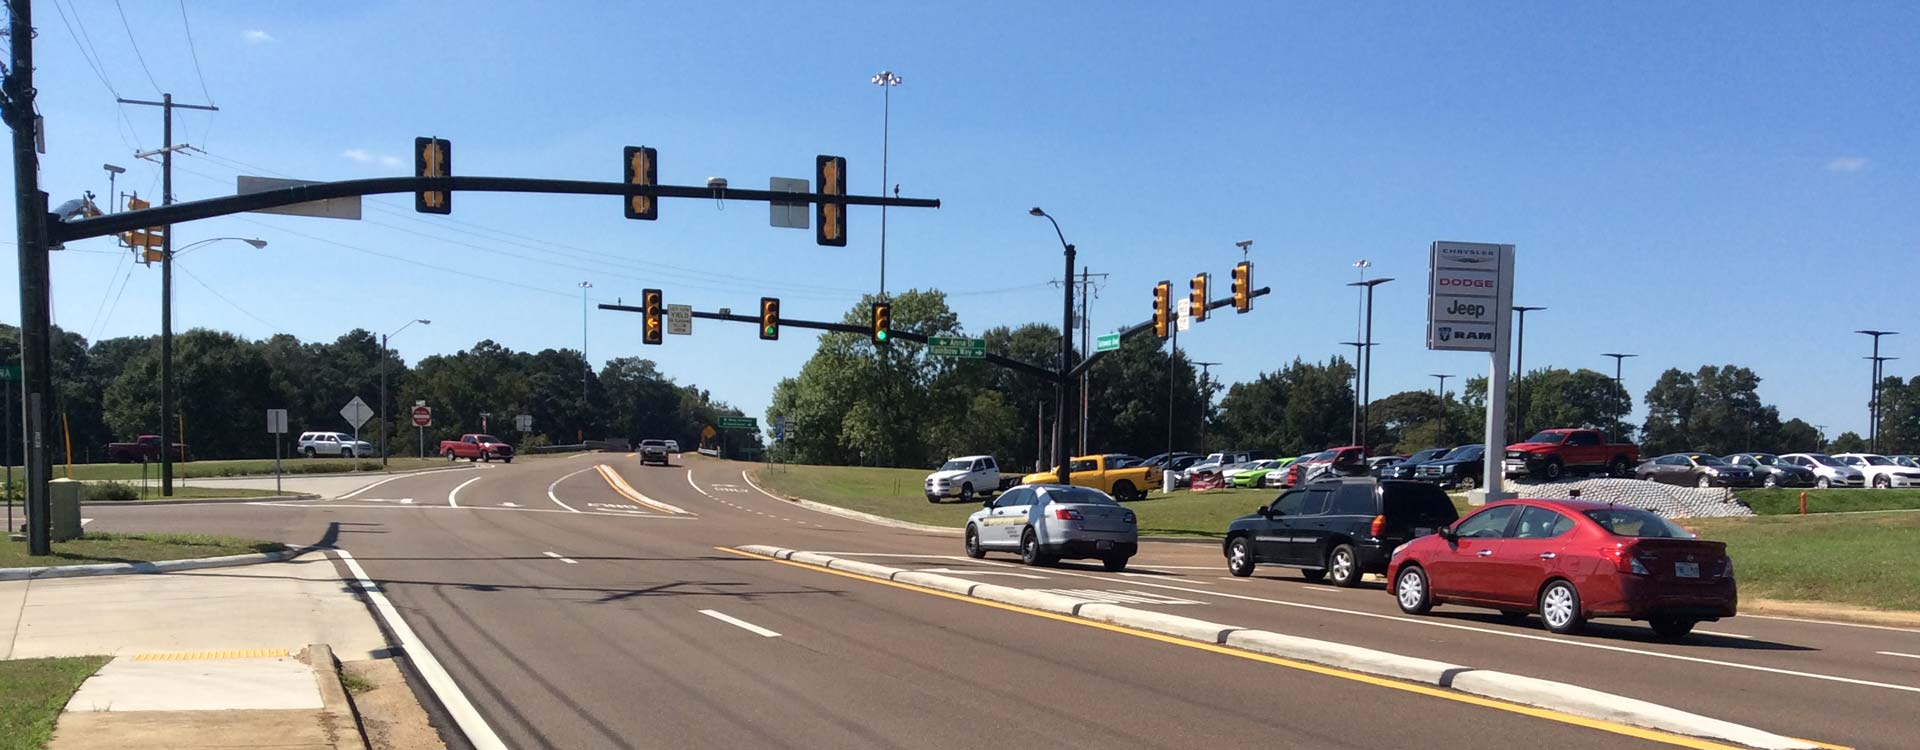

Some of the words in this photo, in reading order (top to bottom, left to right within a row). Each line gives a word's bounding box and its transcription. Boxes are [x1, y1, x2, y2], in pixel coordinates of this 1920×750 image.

[1442, 248, 1495, 256] CHRYSLER
[1439, 278, 1494, 288] DODGE
[1447, 299, 1486, 319] Jeep
[671, 311, 690, 319] YIELD
[1454, 331, 1492, 340] RAM
